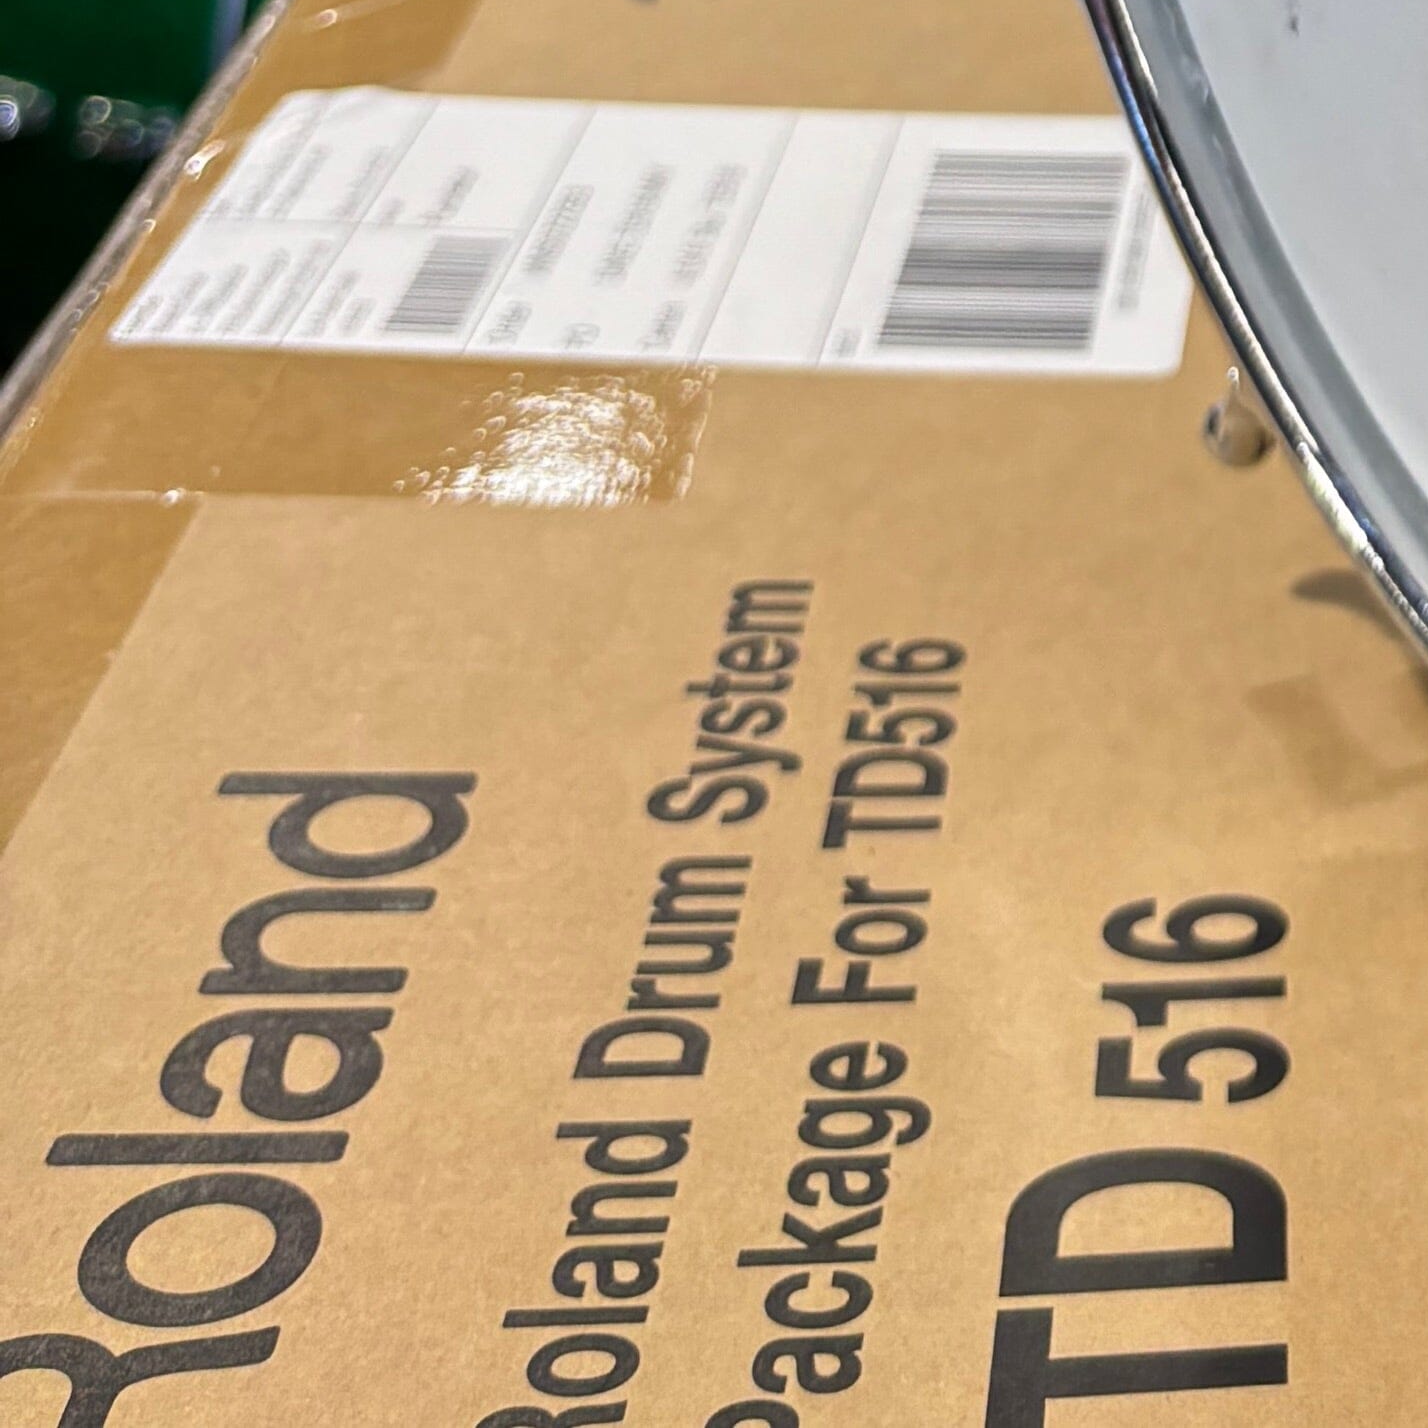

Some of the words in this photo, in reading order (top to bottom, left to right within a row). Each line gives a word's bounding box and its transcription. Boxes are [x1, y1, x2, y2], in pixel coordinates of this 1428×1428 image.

[645, 579, 815, 825] System
[822, 637, 966, 850] TD516
[572, 855, 752, 1079] Drum
[791, 875, 931, 1005] For
[1094, 893, 1291, 1104] 516
[984, 1147, 1288, 1428] TD
